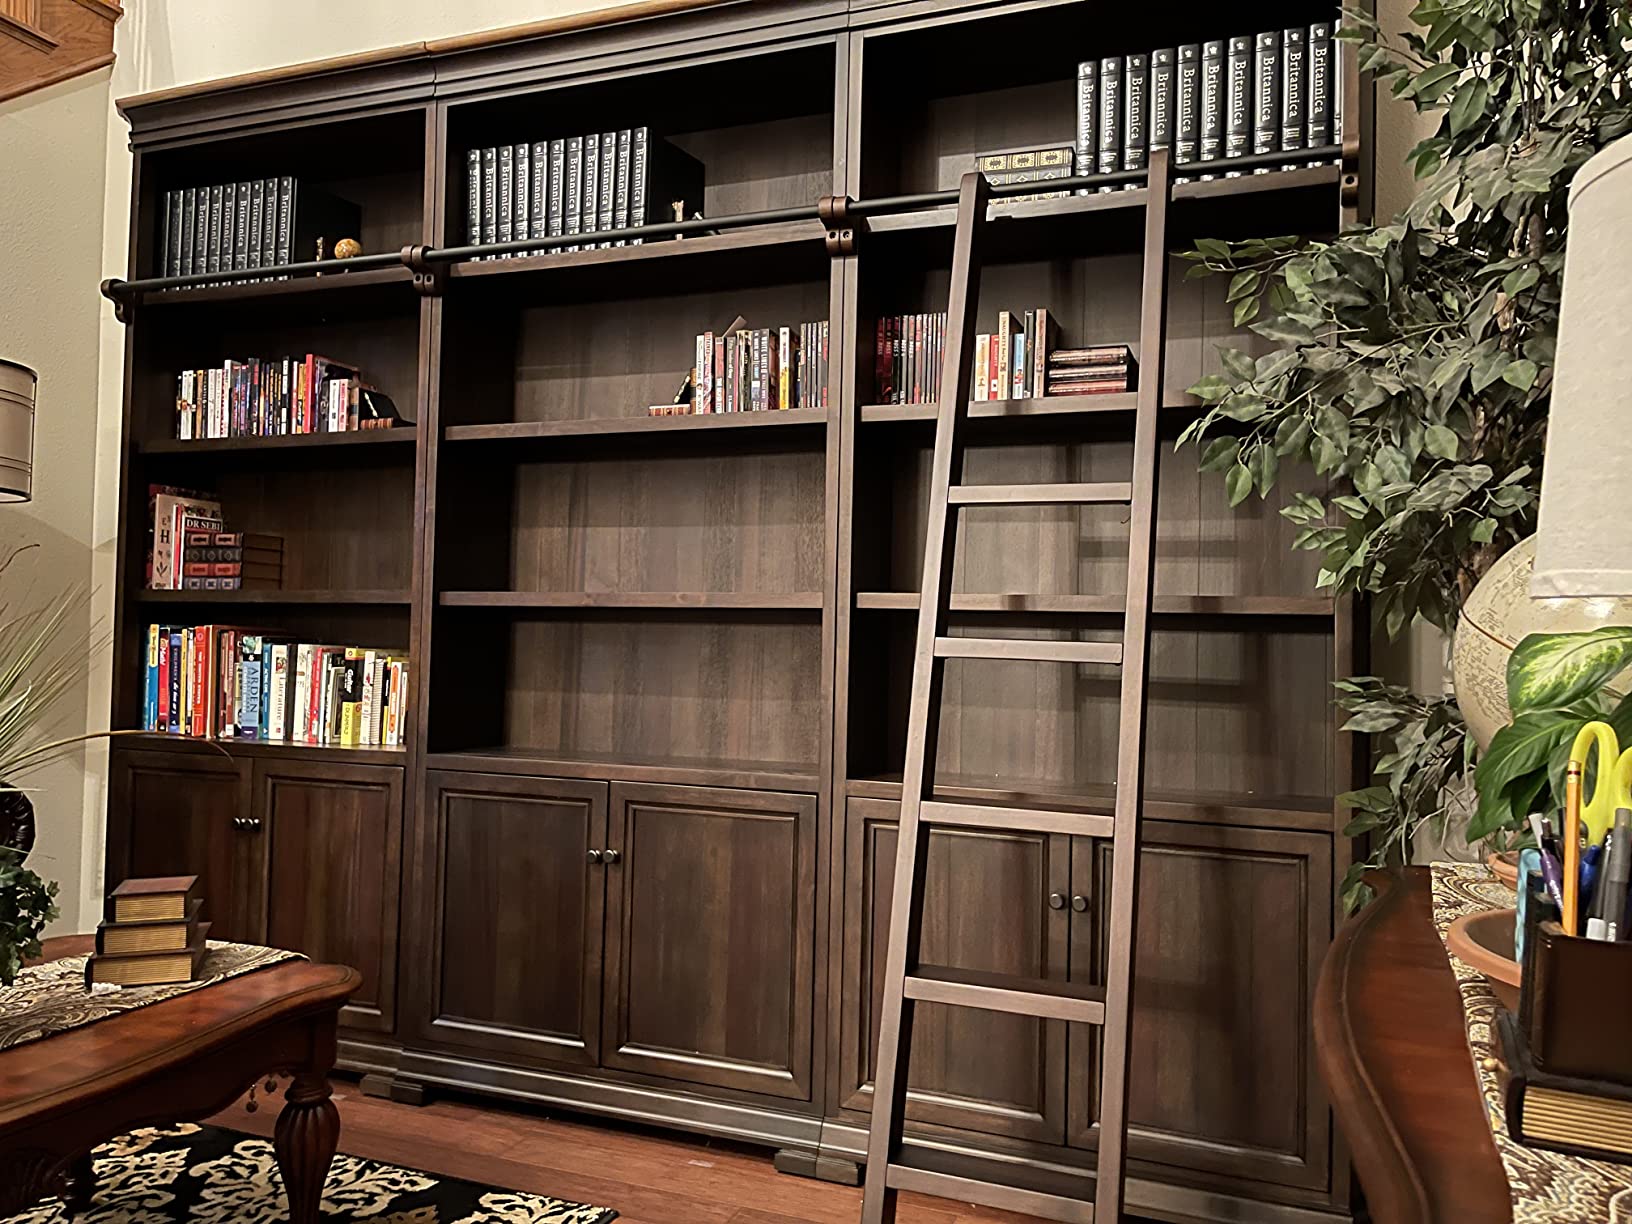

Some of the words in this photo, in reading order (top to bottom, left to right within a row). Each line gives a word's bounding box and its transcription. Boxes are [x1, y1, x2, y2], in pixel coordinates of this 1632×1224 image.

[1156, 73, 1168, 135] Britannica
[1183, 69, 1195, 132] Britannica
[1207, 65, 1219, 129] Britannica
[1233, 60, 1246, 125] Britannica
[1262, 56, 1275, 121] Britannica
[1288, 52, 1301, 117] Britannica
[1314, 47, 1327, 114] Britannica
[1081, 85, 1094, 146] Britannica
[1105, 81, 1117, 143] Britannica
[1131, 77, 1143, 139] Britannica
[485, 168, 493, 218] Britannica
[501, 166, 509, 217] Britannica
[517, 164, 526, 215] Britannica
[534, 162, 543, 213] Britannica
[551, 160, 560, 211] Britannica
[569, 158, 578, 209] Britannica
[586, 156, 596, 207] Britannica
[602, 154, 612, 205] Britannica
[618, 152, 628, 203] Britannica
[634, 149, 645, 201] Britannica
[224, 202, 232, 248] Britannica
[238, 201, 247, 246] Britannica
[251, 198, 260, 245] Britannica
[266, 196, 274, 243] Britannica
[280, 195, 288, 242] Britannica
[186, 519, 199, 528] DR
[201, 520, 221, 531] SEBI
[250, 667, 259, 713] ARDEN
[277, 677, 286, 720] Literature
[346, 669, 354, 693] Guitar
